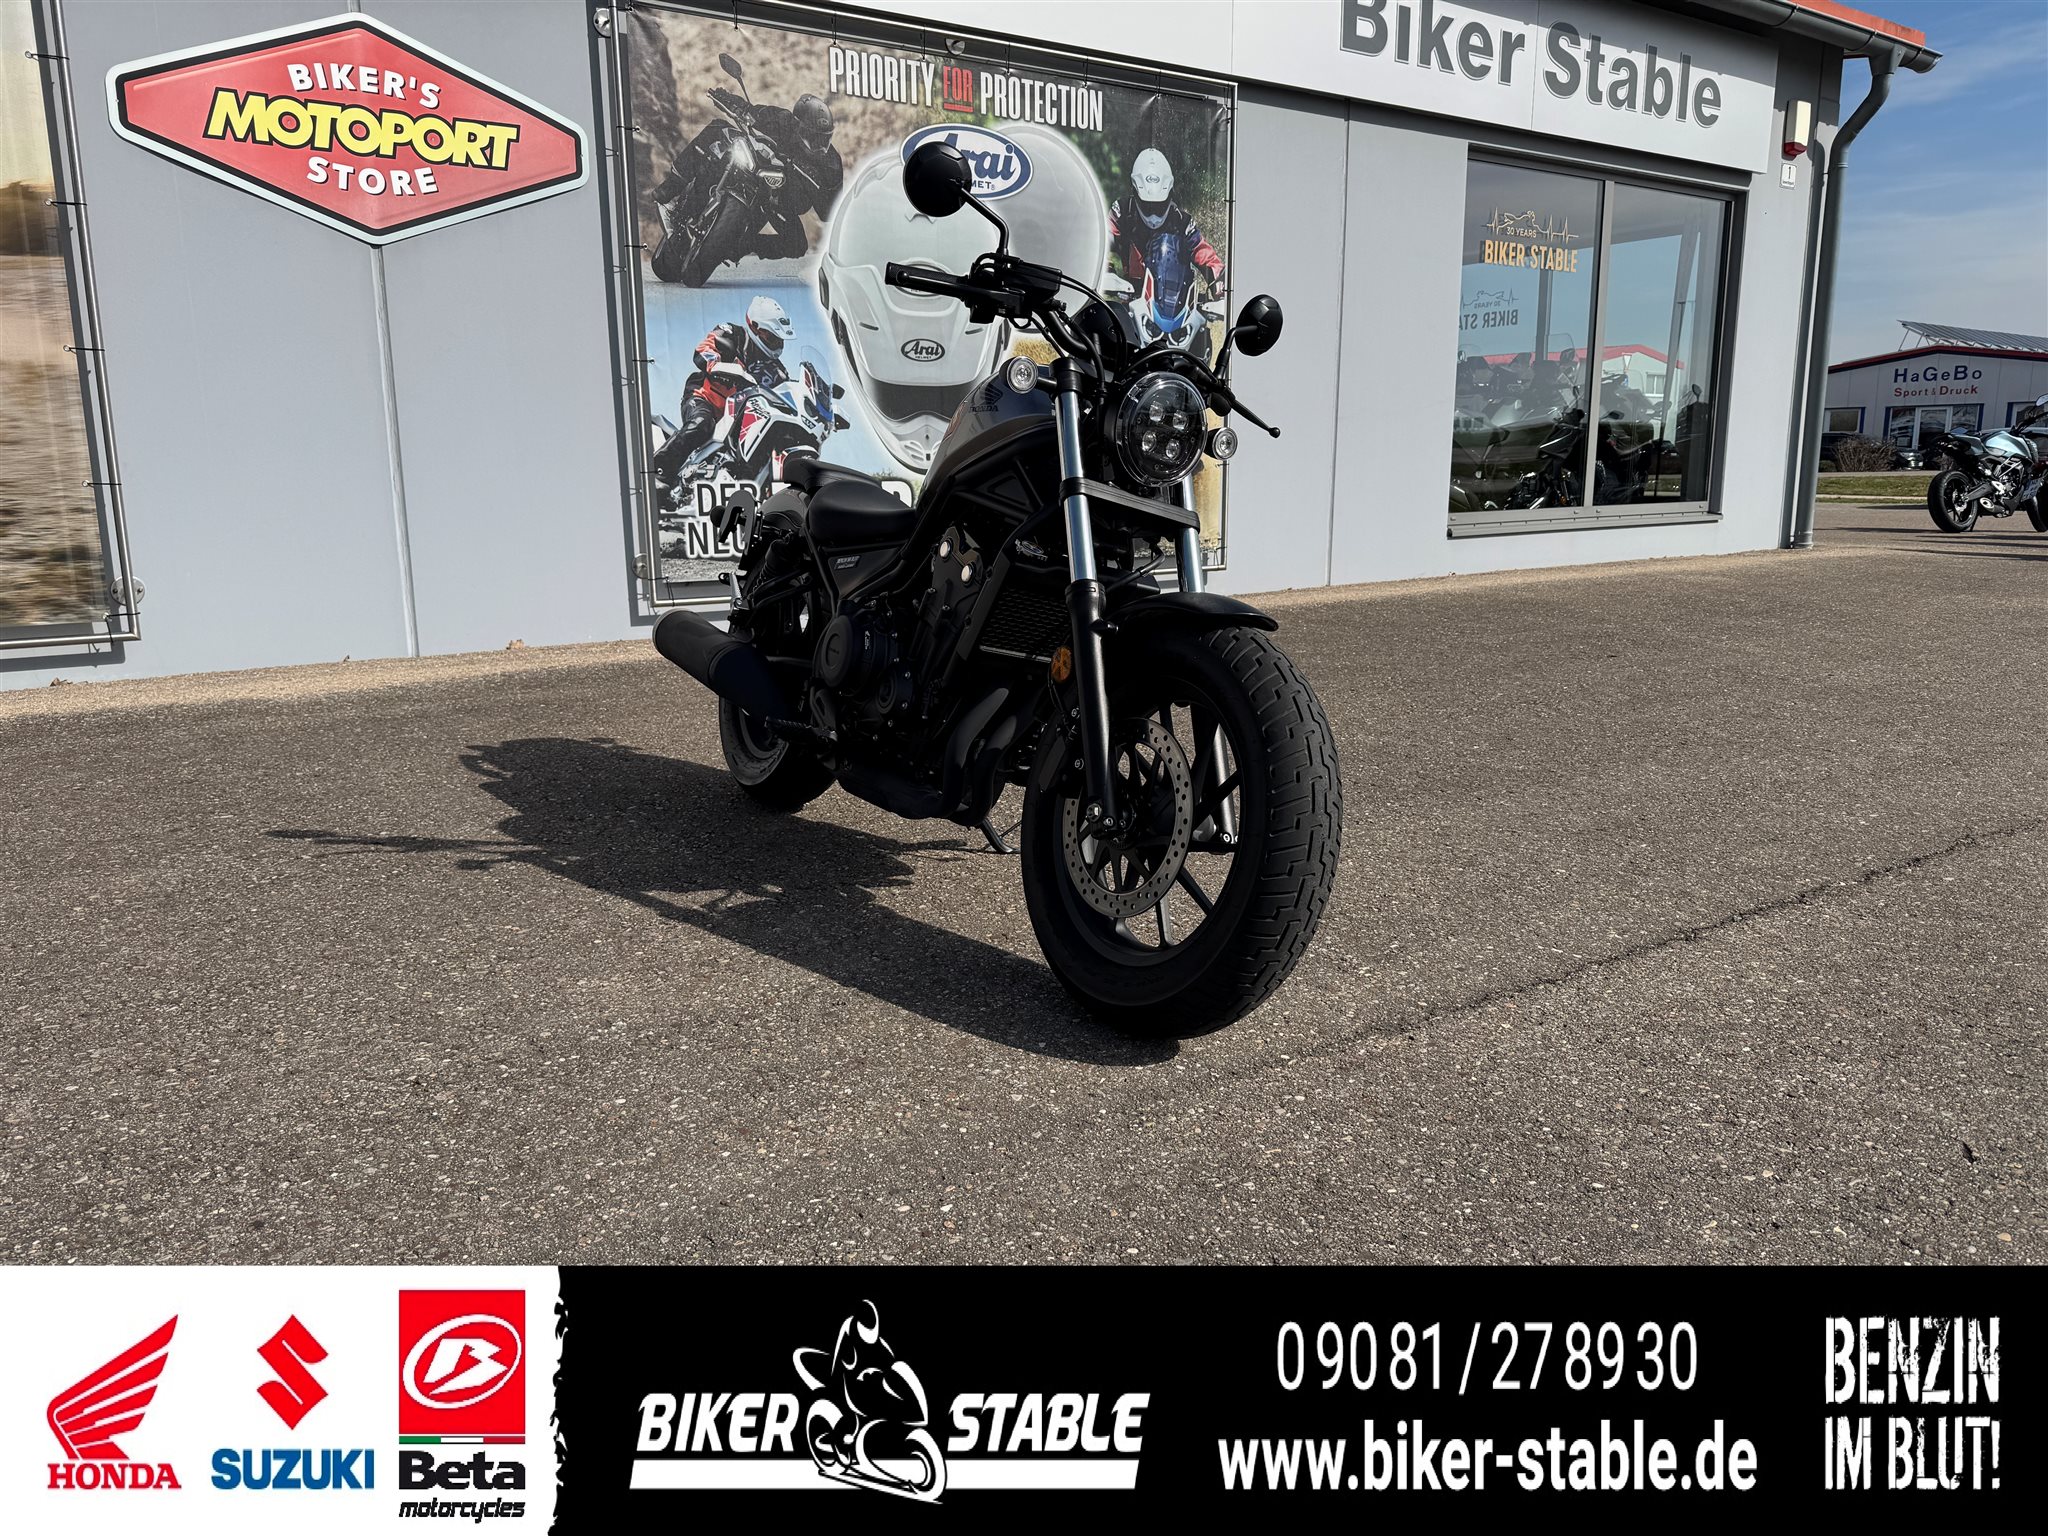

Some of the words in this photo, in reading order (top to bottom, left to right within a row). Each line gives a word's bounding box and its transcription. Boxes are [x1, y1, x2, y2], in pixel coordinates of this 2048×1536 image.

[1340, 0, 1525, 86] Biker
[1543, 21, 1723, 128] Stable
[287, 63, 442, 109] BIKER'S
[829, 46, 935, 107] PRIORITY
[943, 65, 974, 105] FOR
[980, 71, 1103, 132] PROTECTION
[204, 88, 519, 170] MOTOPORT
[306, 156, 439, 196] STORE
[944, 133, 1017, 180] rai
[1506, 226, 1515, 236] 30
[1516, 228, 1537, 238] YEARS
[1484, 239, 1525, 267] BIKER
[1530, 244, 1578, 273] STABLE
[904, 340, 941, 356] Arai
[1893, 365, 1982, 383] HaGeBo
[1894, 387, 1928, 398] Sport
[1940, 385, 1978, 395] Druck
